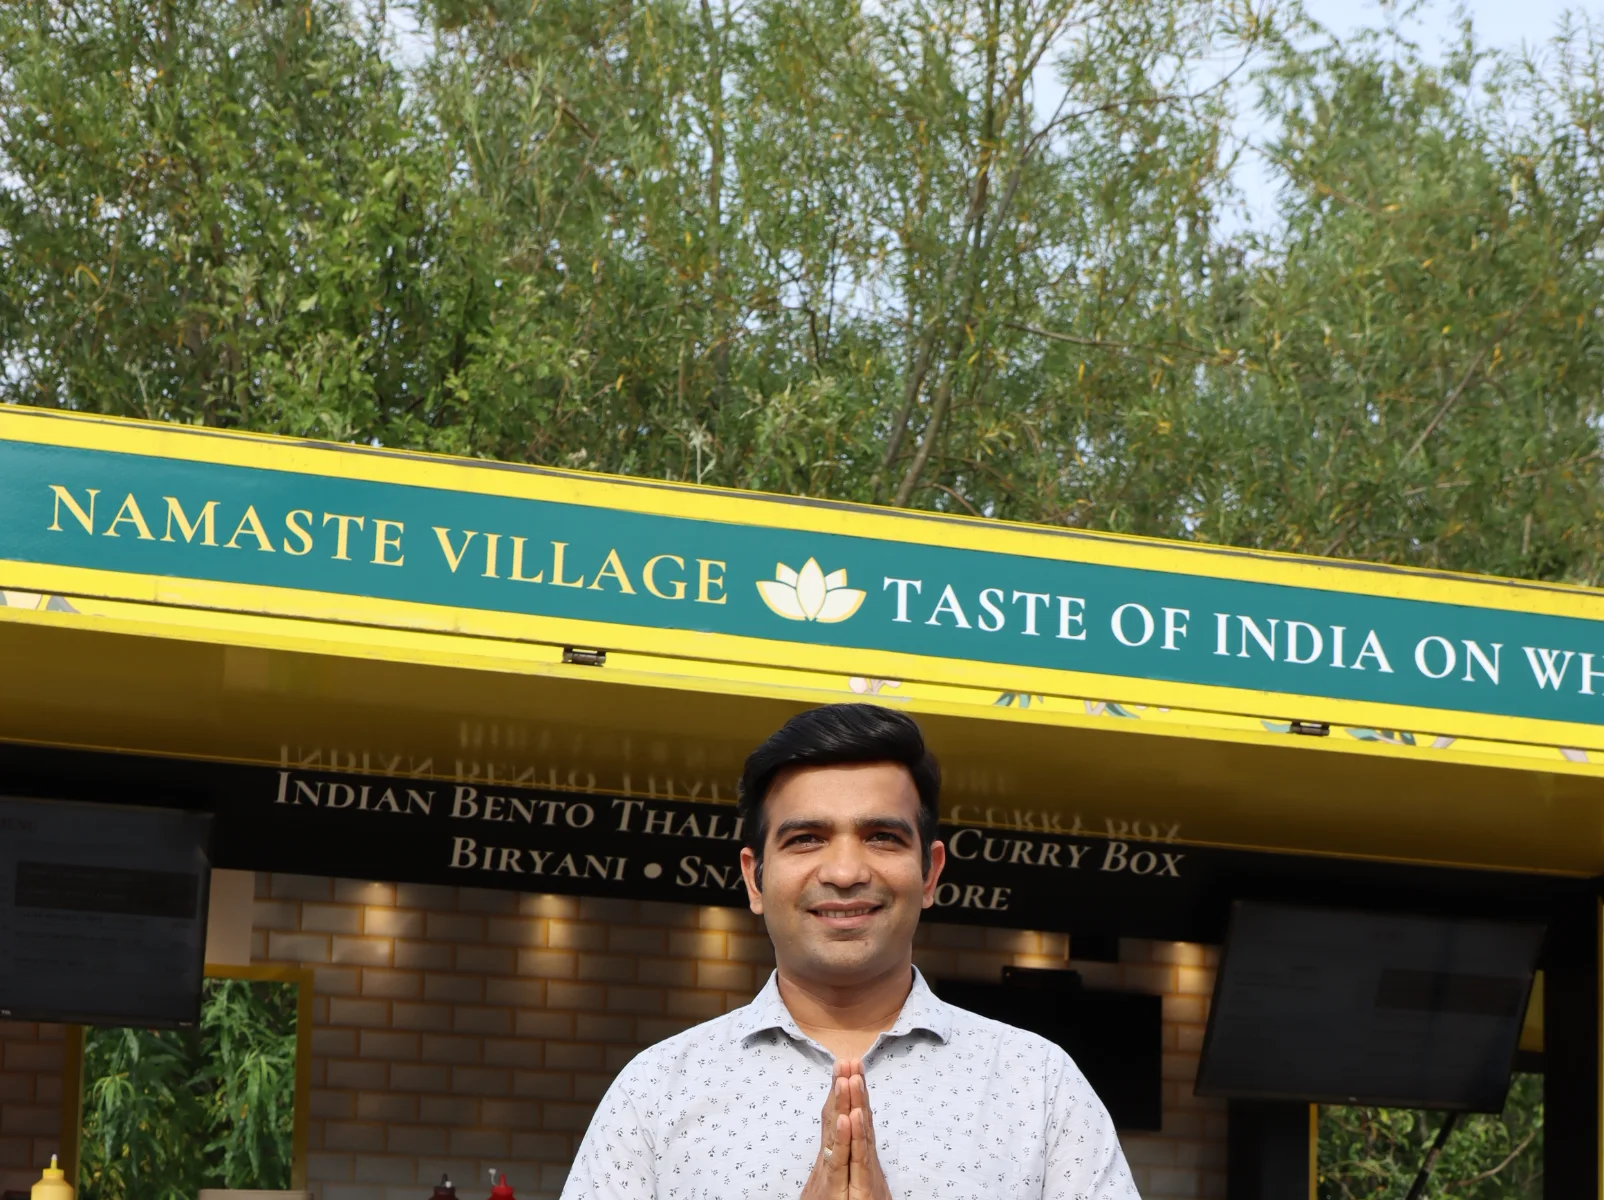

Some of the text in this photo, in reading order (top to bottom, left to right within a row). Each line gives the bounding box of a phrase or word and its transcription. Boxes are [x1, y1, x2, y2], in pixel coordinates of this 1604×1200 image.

[47, 484, 729, 606] NAMASTE VILLAGE
[883, 577, 1088, 641] TASTE
[1111, 602, 1191, 651] OF
[1213, 612, 1395, 674] INDIA
[1414, 635, 1504, 686] ON
[275, 771, 435, 816] INDIAN
[450, 786, 595, 829] BENTO
[949, 828, 1092, 869] CURRY
[1100, 841, 1187, 878] BOX
[449, 836, 628, 881] BIRYANI
